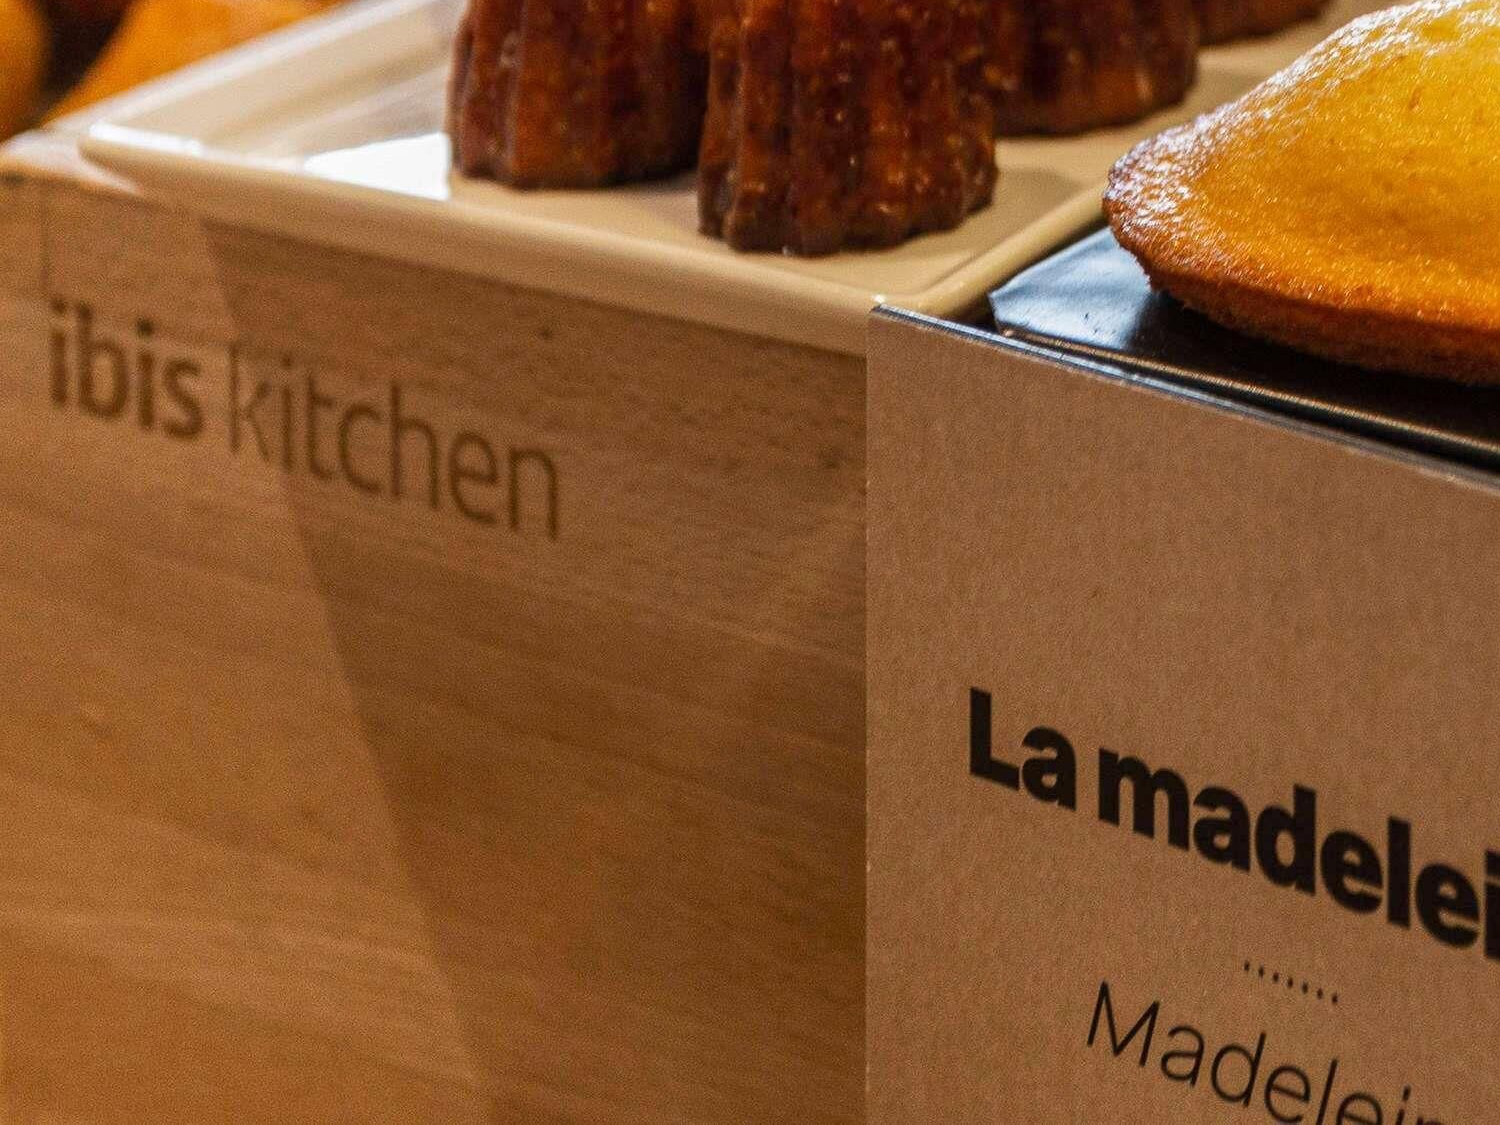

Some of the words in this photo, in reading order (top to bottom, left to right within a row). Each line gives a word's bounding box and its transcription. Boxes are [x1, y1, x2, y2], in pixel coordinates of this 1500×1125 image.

[49, 298, 203, 440] ibis
[227, 343, 560, 543] kitchen
[968, 687, 1078, 811] La
[1086, 980, 1445, 1125] Madelei
